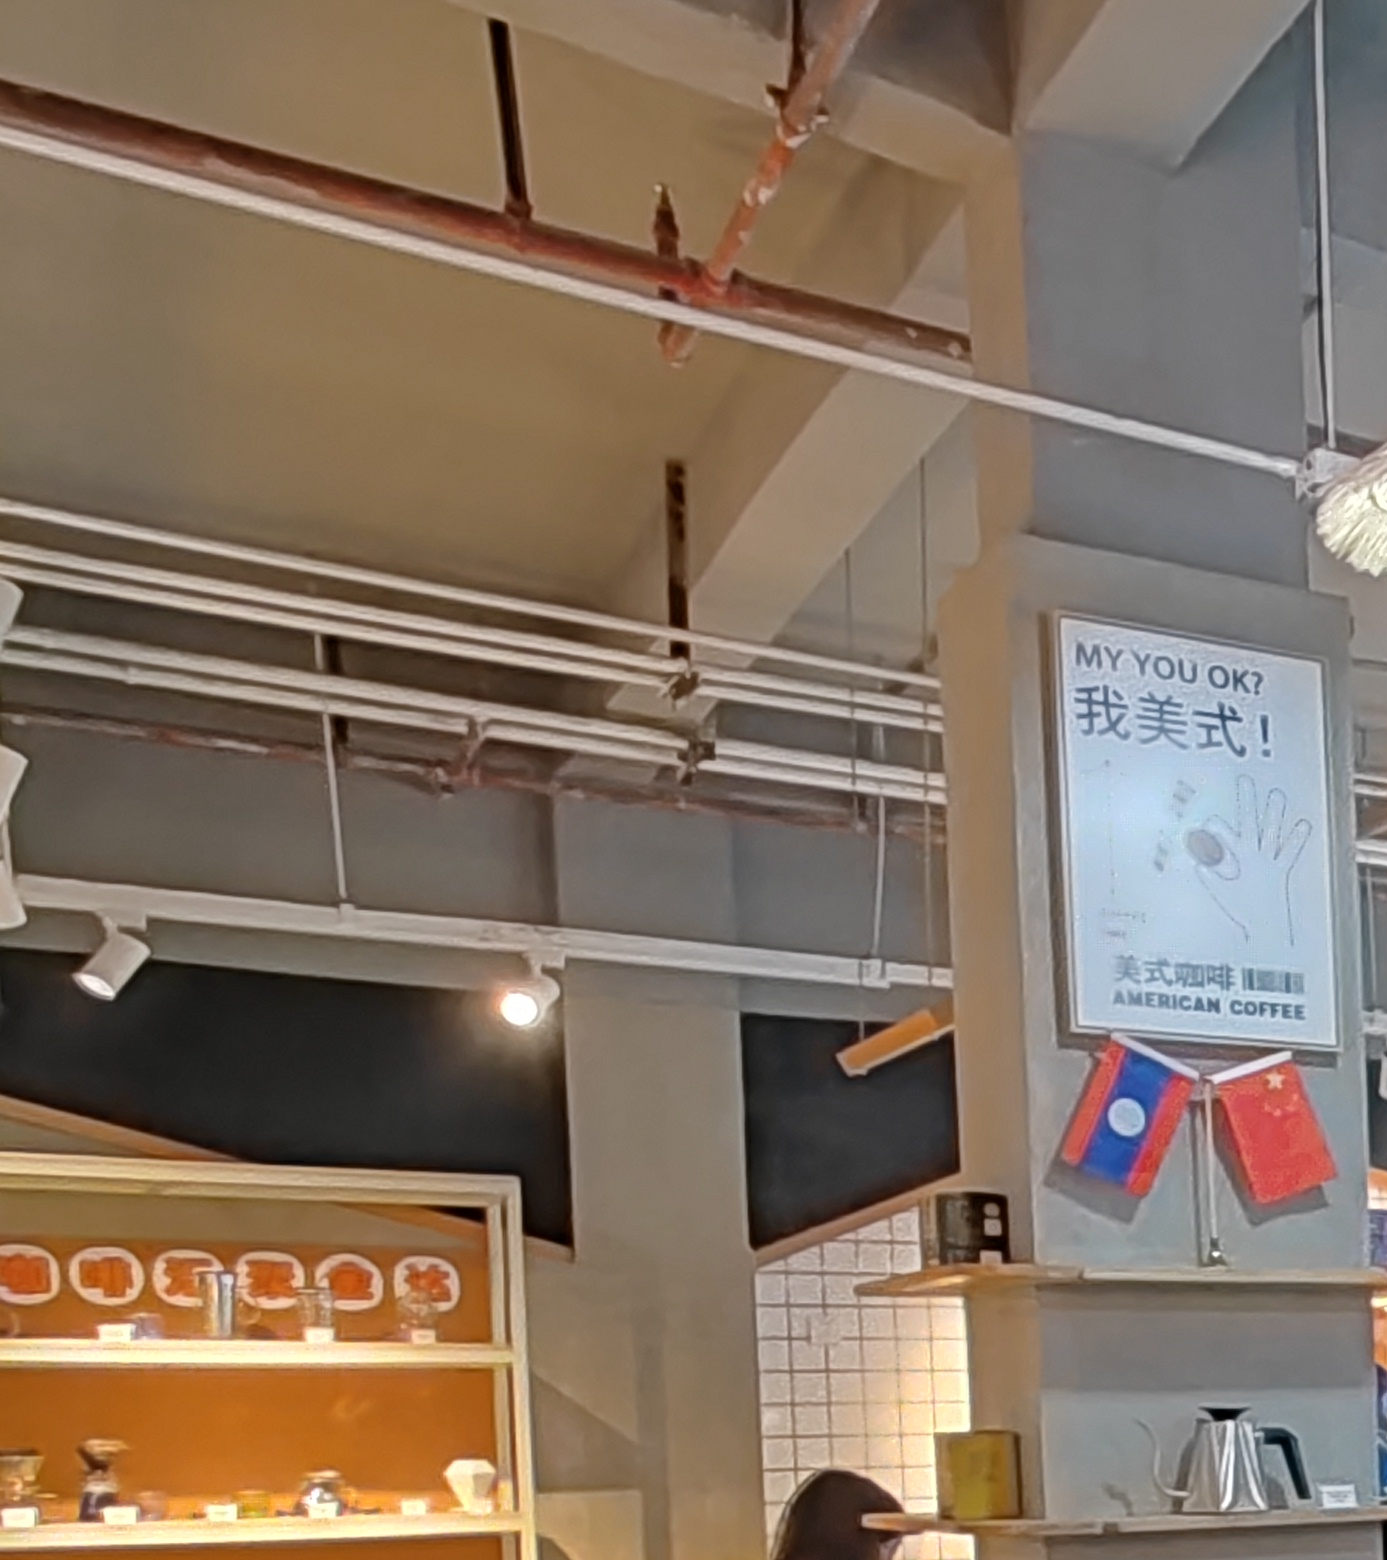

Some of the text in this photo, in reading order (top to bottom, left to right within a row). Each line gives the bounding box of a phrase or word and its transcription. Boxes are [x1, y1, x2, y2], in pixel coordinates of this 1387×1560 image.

[1075, 643, 1264, 696] MY YOU OK?
[1113, 954, 1236, 992] 美式咖啡
[1112, 989, 1306, 1021] AMERICAN COFFEE
